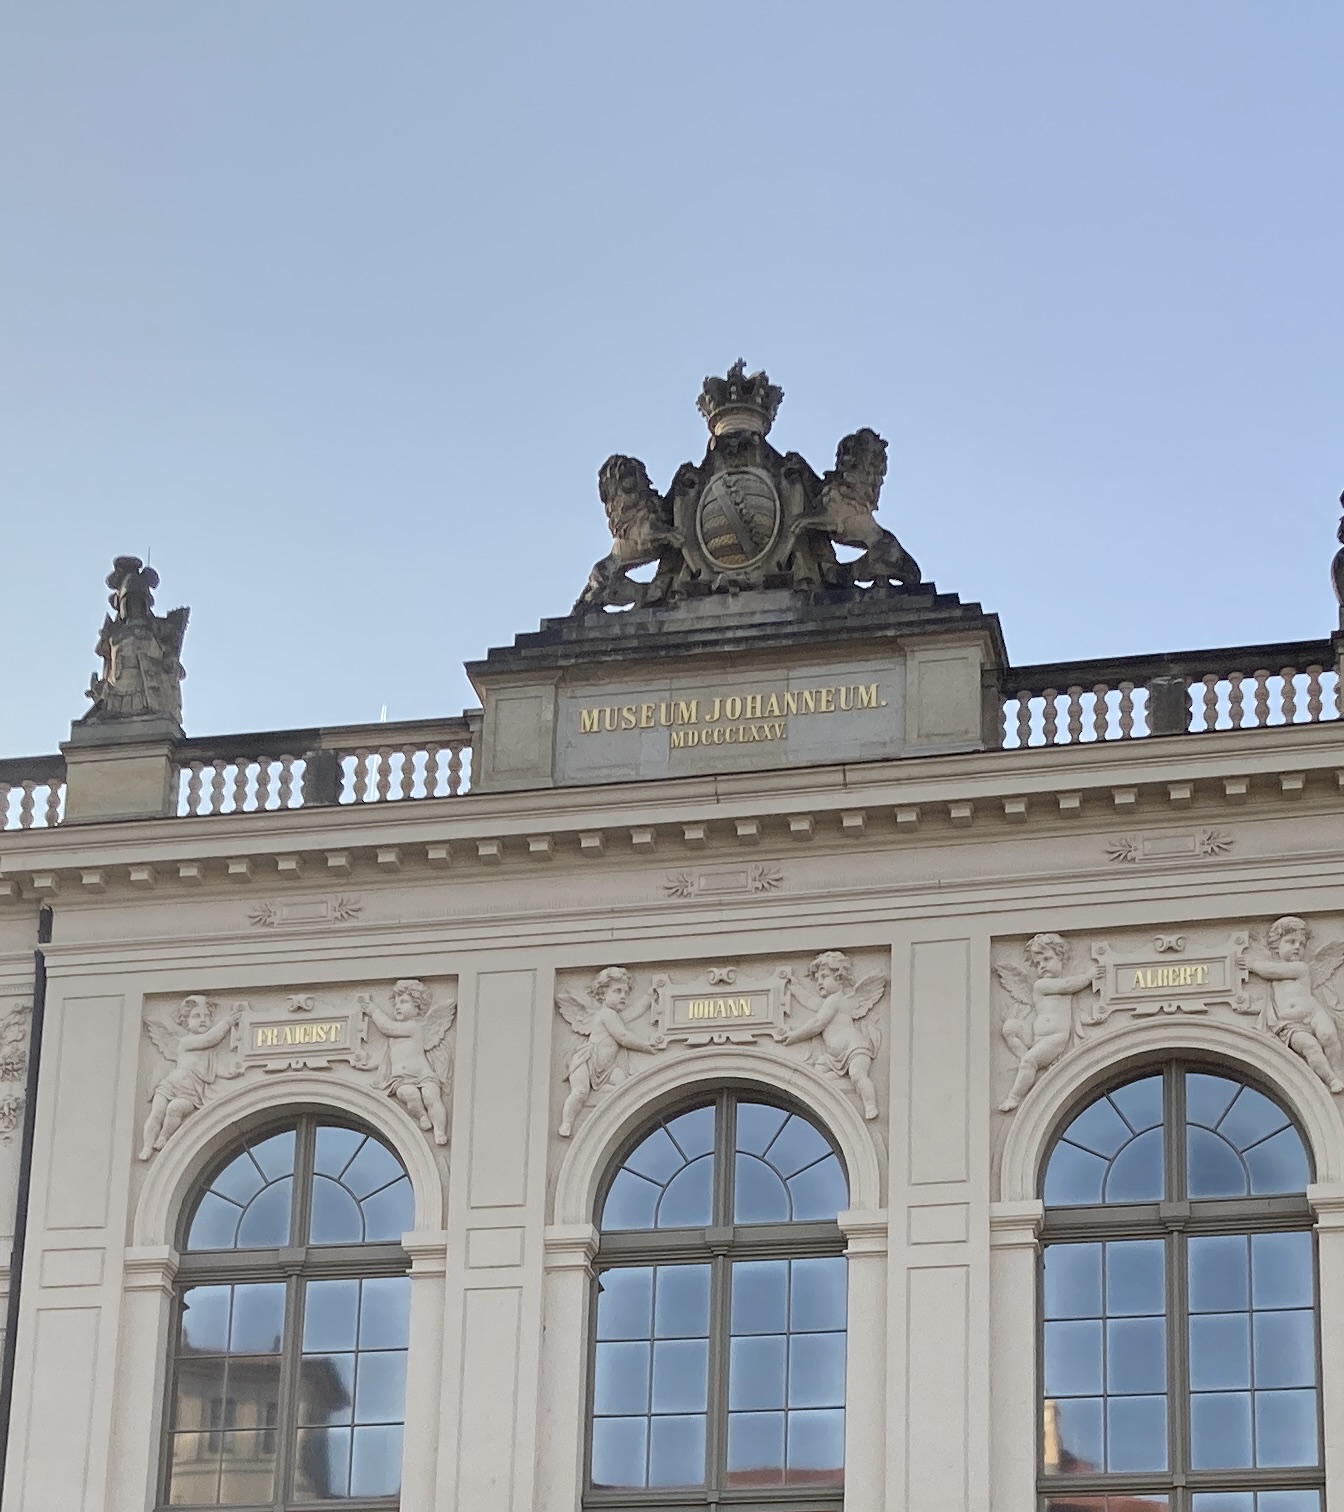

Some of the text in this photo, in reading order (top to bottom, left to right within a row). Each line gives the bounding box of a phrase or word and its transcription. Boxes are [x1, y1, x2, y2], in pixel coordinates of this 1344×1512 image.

[578, 683, 889, 734] MUSEUM JOHANNEUM.
[670, 723, 788, 749] MDCCCLXXV.
